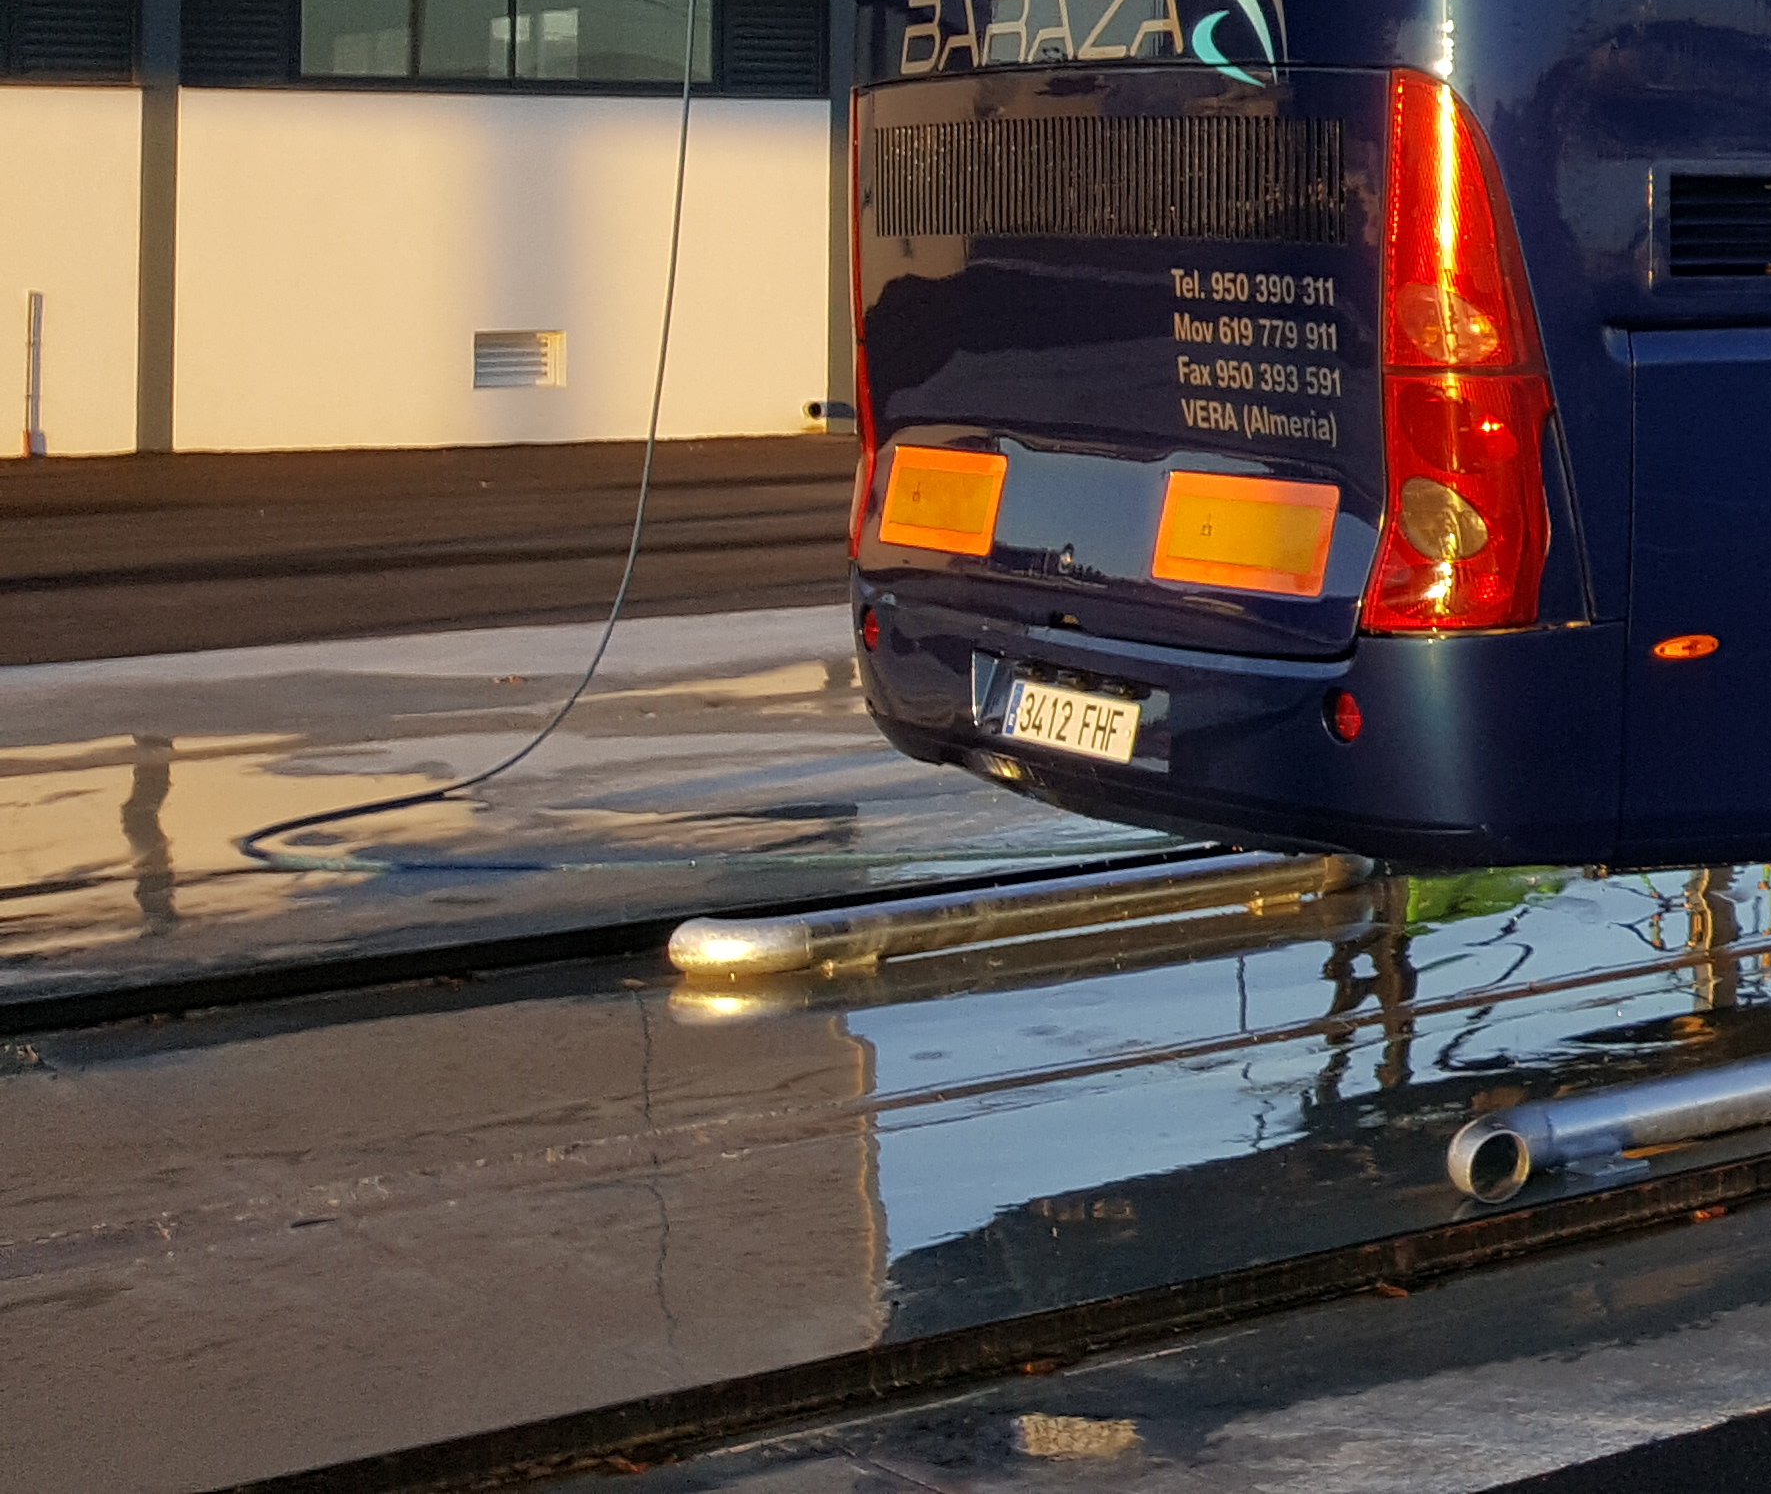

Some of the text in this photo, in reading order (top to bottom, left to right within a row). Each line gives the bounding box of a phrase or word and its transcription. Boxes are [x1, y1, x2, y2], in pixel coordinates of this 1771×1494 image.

[1171, 268, 1335, 307] Tel. 950 390 311
[1173, 312, 1338, 353] Mov 619 779 911
[1176, 355, 1342, 398] Fax 950 393 591
[1180, 398, 1338, 448] VERA (Almeria)
[1019, 692, 1125, 753] 3412 FHF
